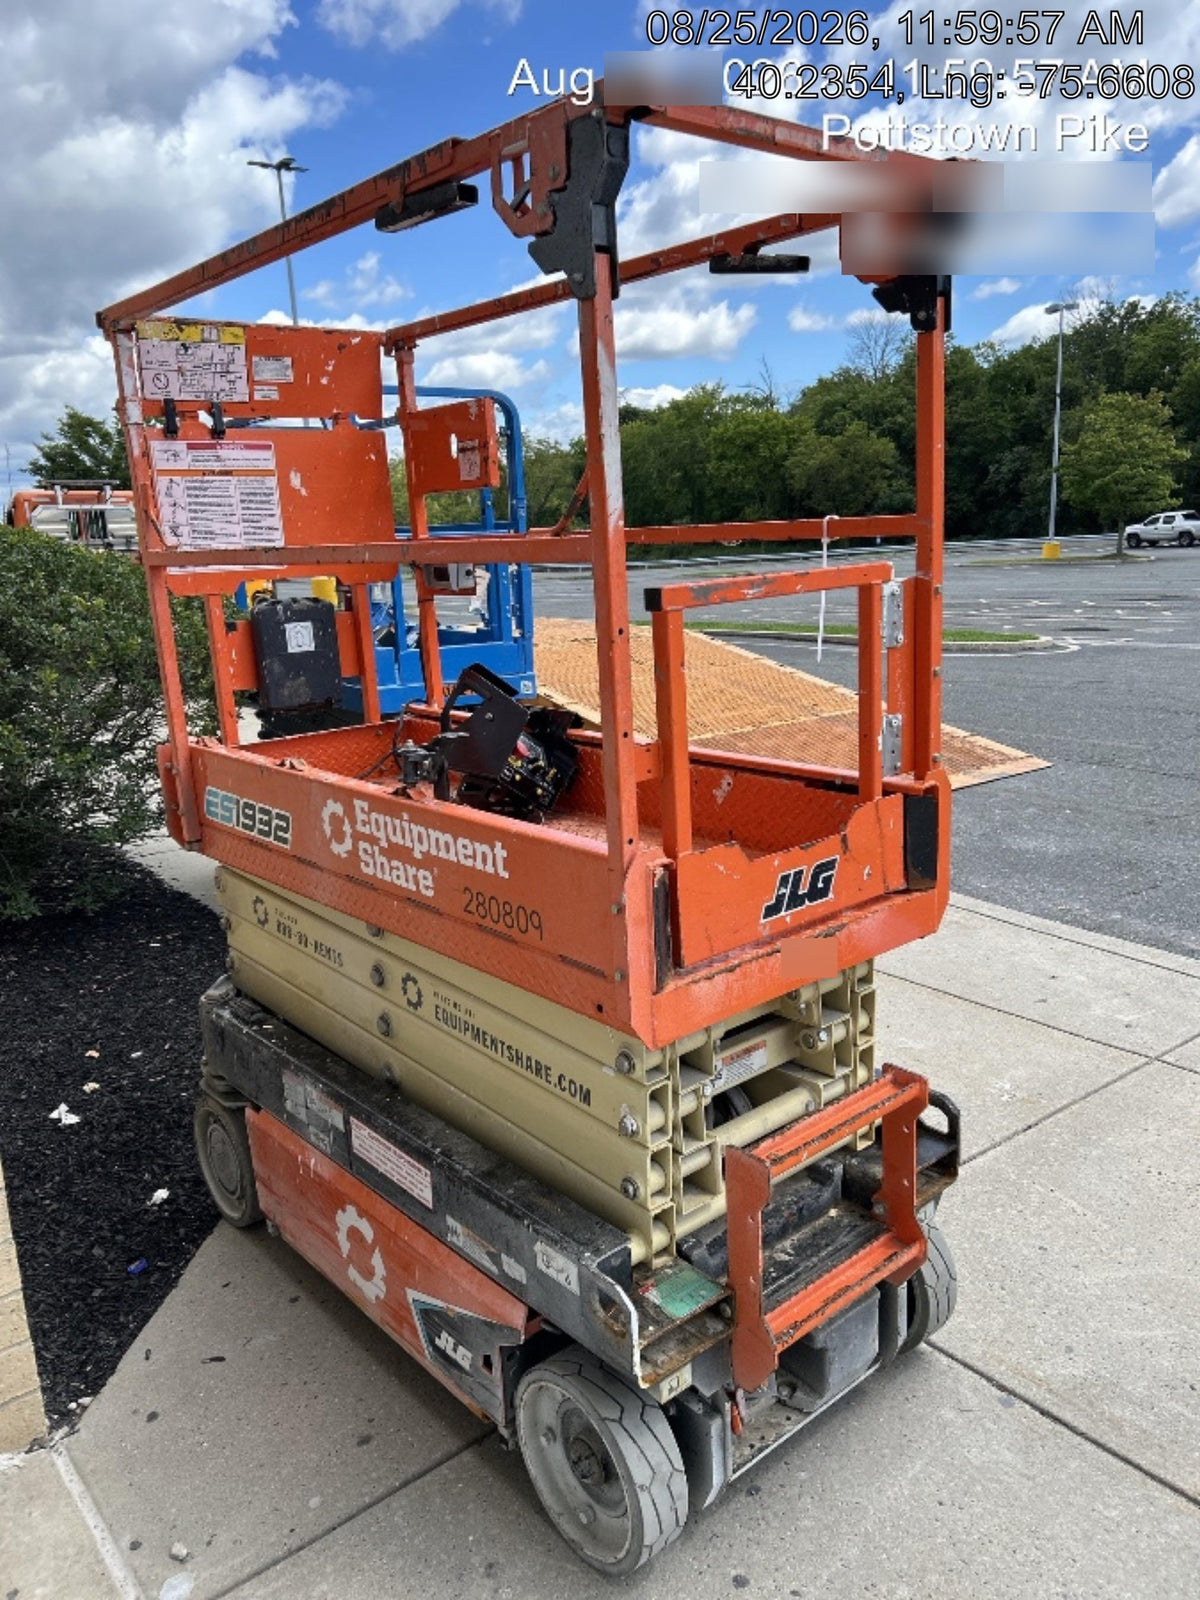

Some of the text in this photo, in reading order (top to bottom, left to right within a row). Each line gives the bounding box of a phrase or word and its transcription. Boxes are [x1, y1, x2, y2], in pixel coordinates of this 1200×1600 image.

[204, 785, 292, 849] ES1932
[353, 799, 509, 879] Equipment
[358, 840, 435, 897] Share
[760, 855, 840, 923] JLG
[463, 886, 543, 941] 280809
[434, 1003, 591, 1107] EQUIPMENTSHARE.COM
[434, 1329, 473, 1371] JLG
